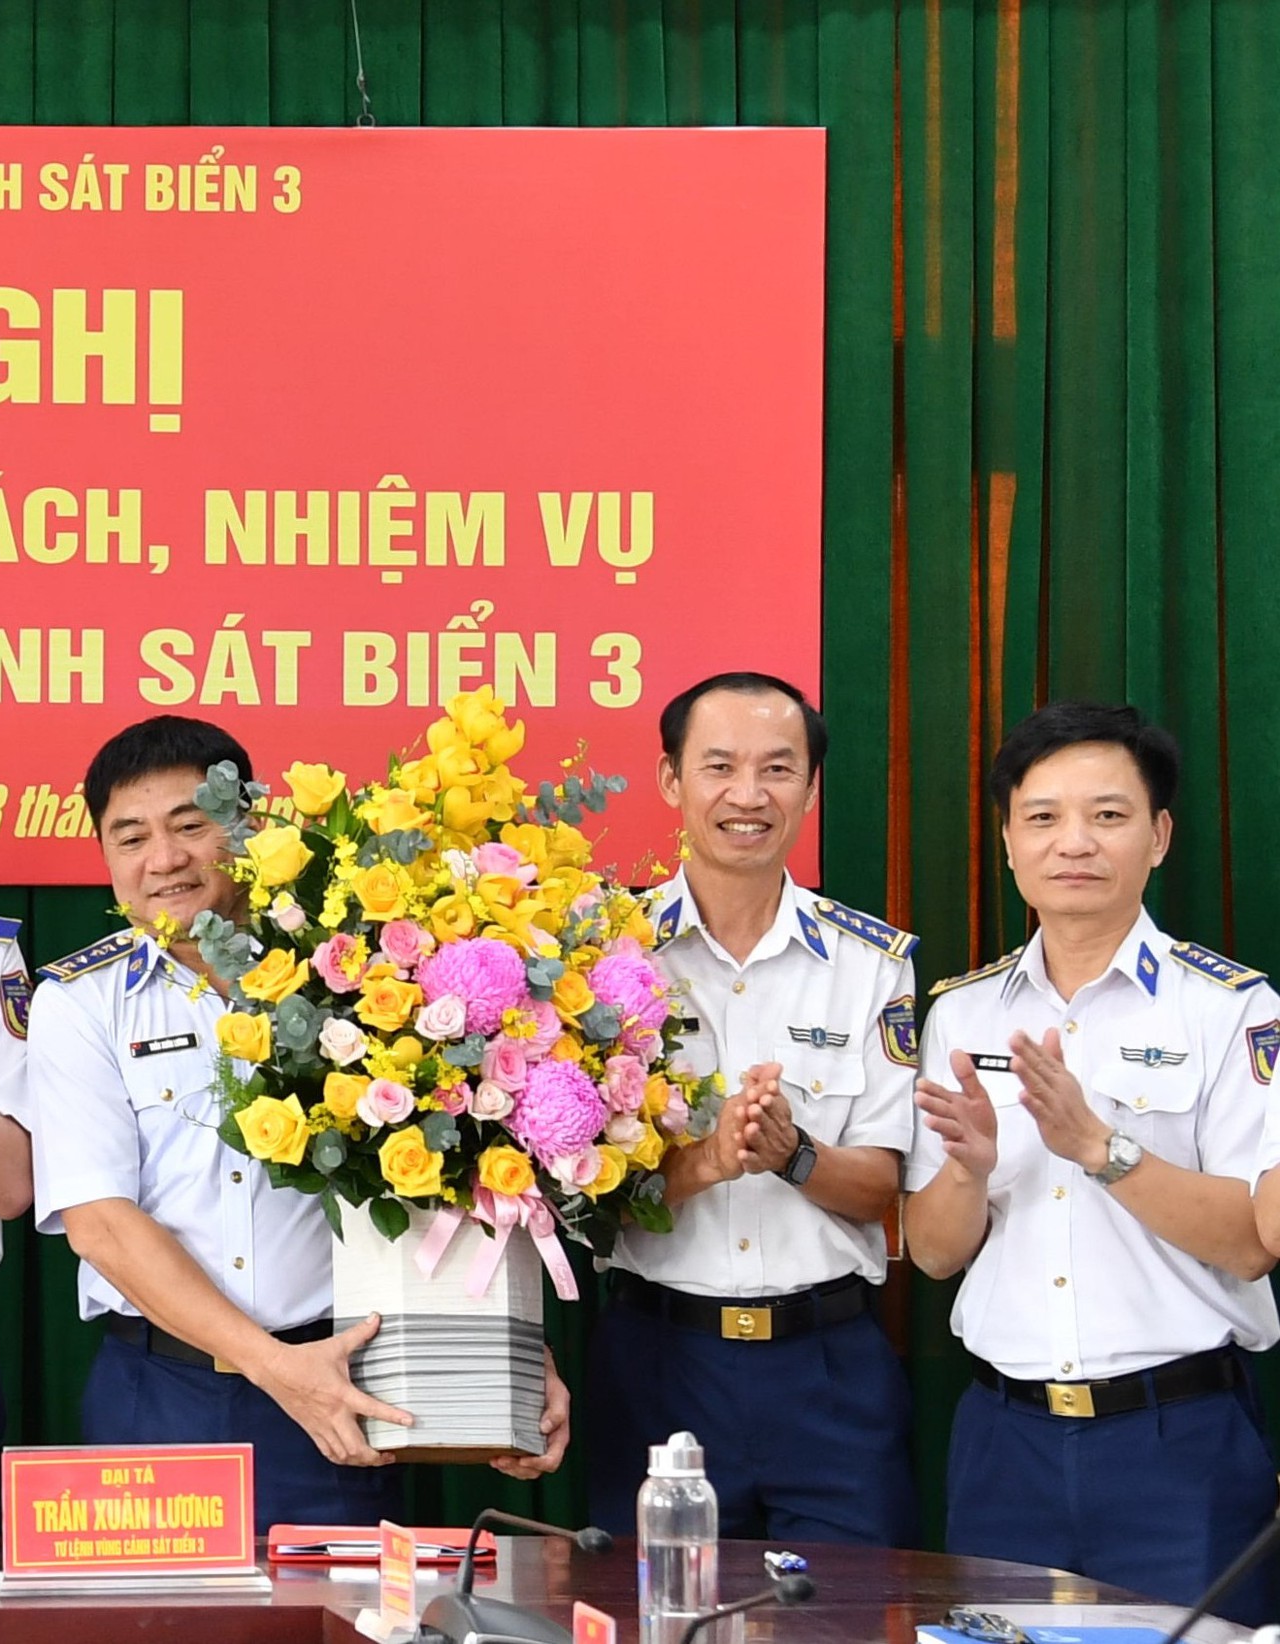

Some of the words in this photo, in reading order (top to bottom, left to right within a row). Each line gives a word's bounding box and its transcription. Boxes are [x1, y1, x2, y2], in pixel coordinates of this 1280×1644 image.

[38, 153, 130, 211] SÁT
[145, 145, 257, 212] BIỂN
[273, 165, 301, 213] 3
[204, 474, 505, 584] NHIỆM
[538, 491, 654, 585] VỤ
[138, 613, 312, 706] SÁT
[343, 599, 557, 707] BIỂN
[590, 632, 642, 709] 3
[14, 782, 97, 838] thá
[101, 1468, 130, 1488] ĐẠI
[134, 1464, 155, 1485] TÁ
[32, 1489, 88, 1533] TRẦN
[93, 1491, 150, 1532] XUÂN
[155, 1493, 224, 1530] LƯƠNG
[197, 1537, 205, 1554] 3
